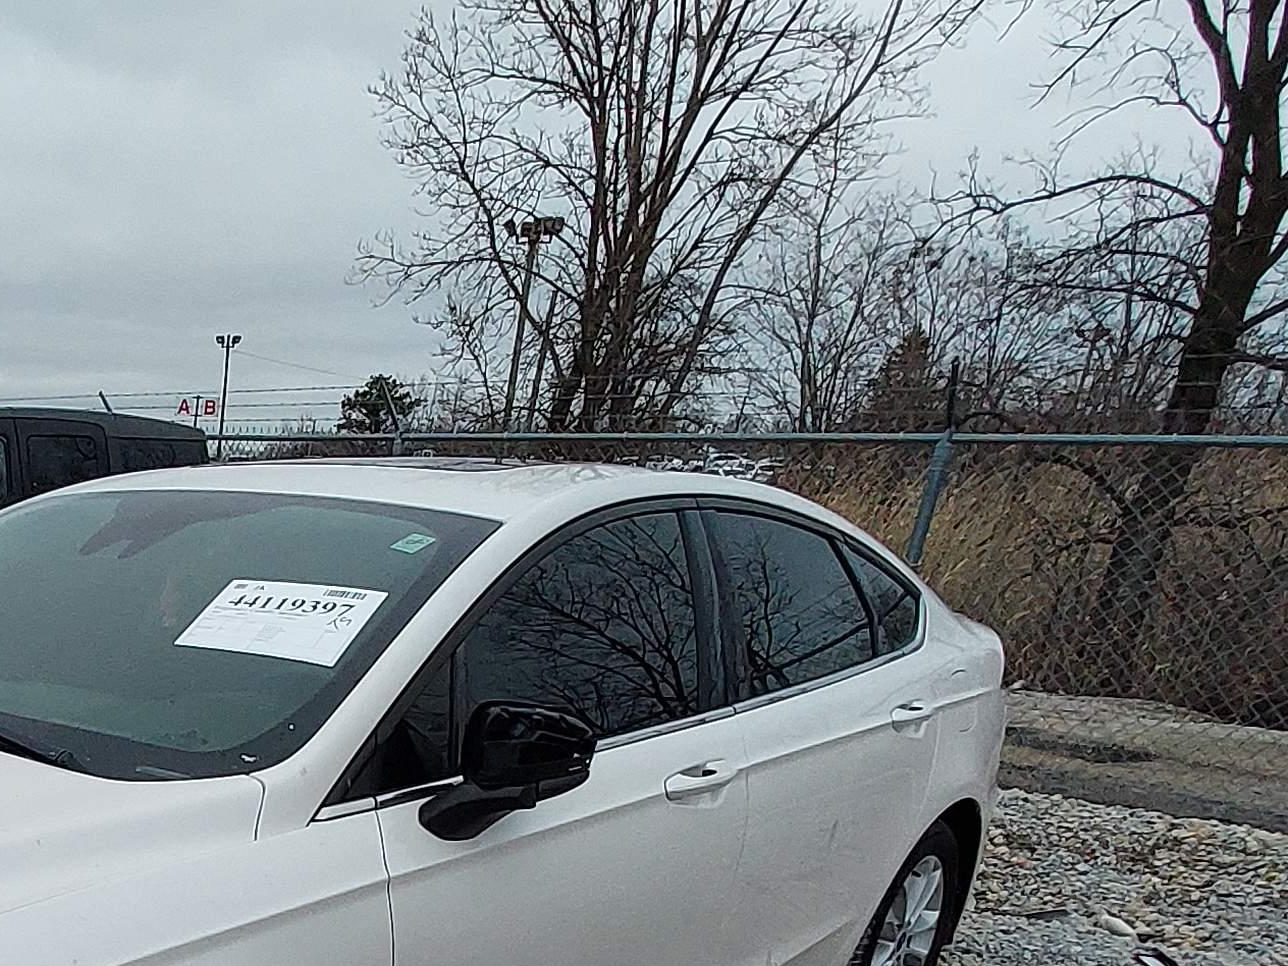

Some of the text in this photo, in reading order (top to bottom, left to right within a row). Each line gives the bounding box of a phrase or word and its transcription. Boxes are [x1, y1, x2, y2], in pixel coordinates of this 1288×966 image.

[176, 399, 216, 415] A B
[228, 594, 356, 617] 44119397
